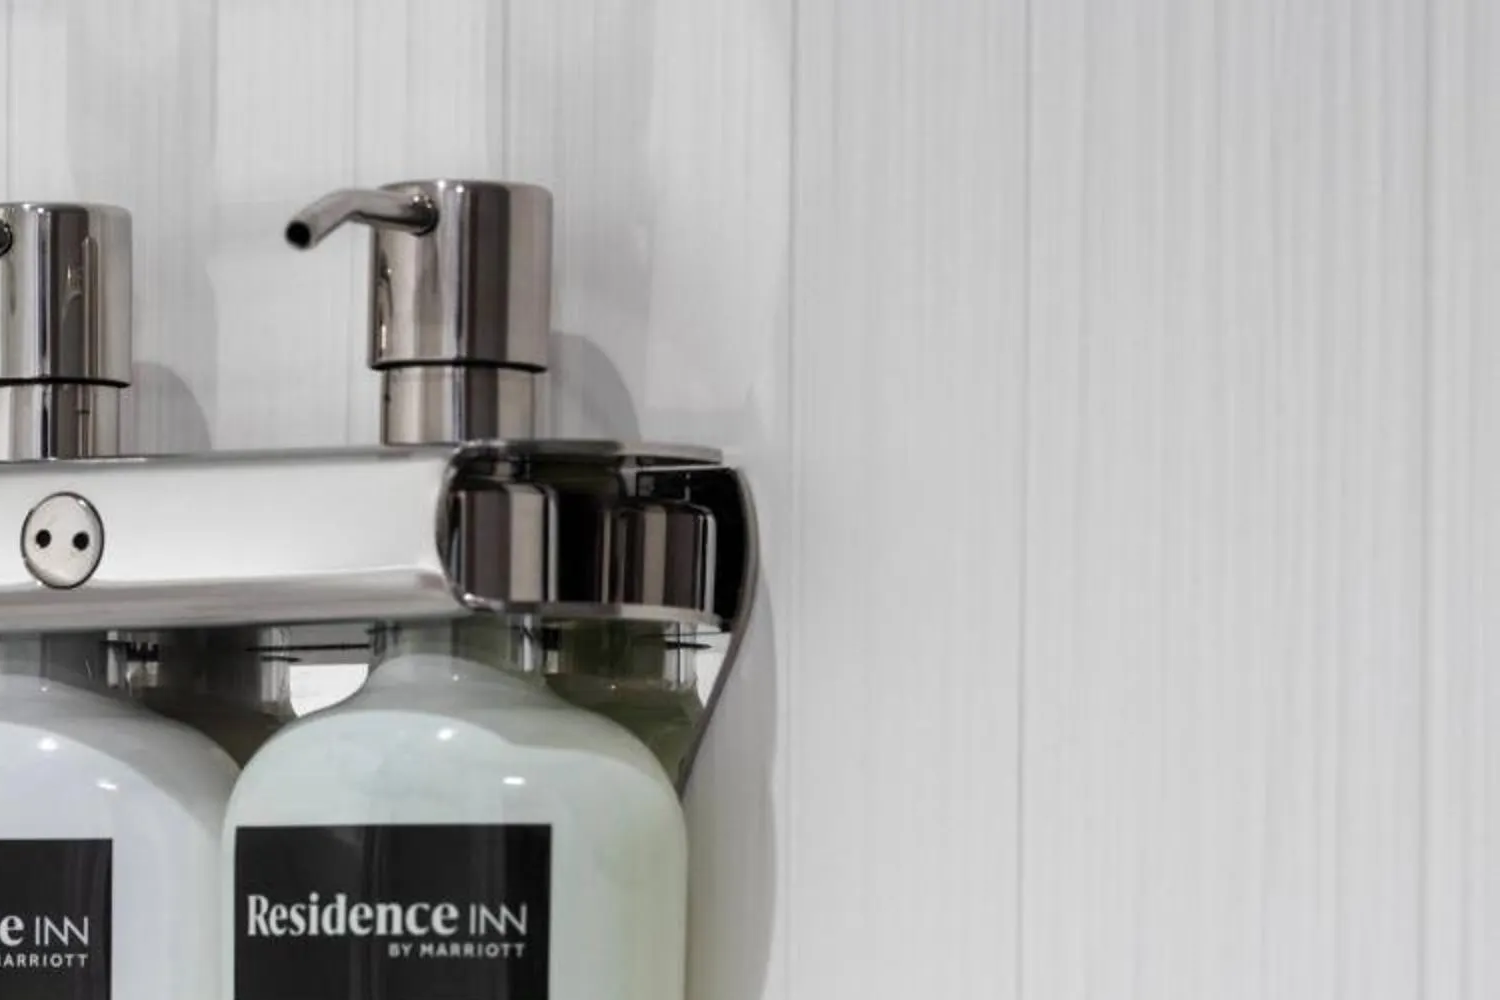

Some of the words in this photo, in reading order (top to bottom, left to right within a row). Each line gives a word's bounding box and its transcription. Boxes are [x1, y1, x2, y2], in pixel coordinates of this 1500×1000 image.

[247, 892, 459, 937] Residence
[469, 903, 527, 935] INN
[35, 915, 90, 946] INN
[388, 943, 411, 957] BY
[420, 943, 525, 957] MARRIOTT
